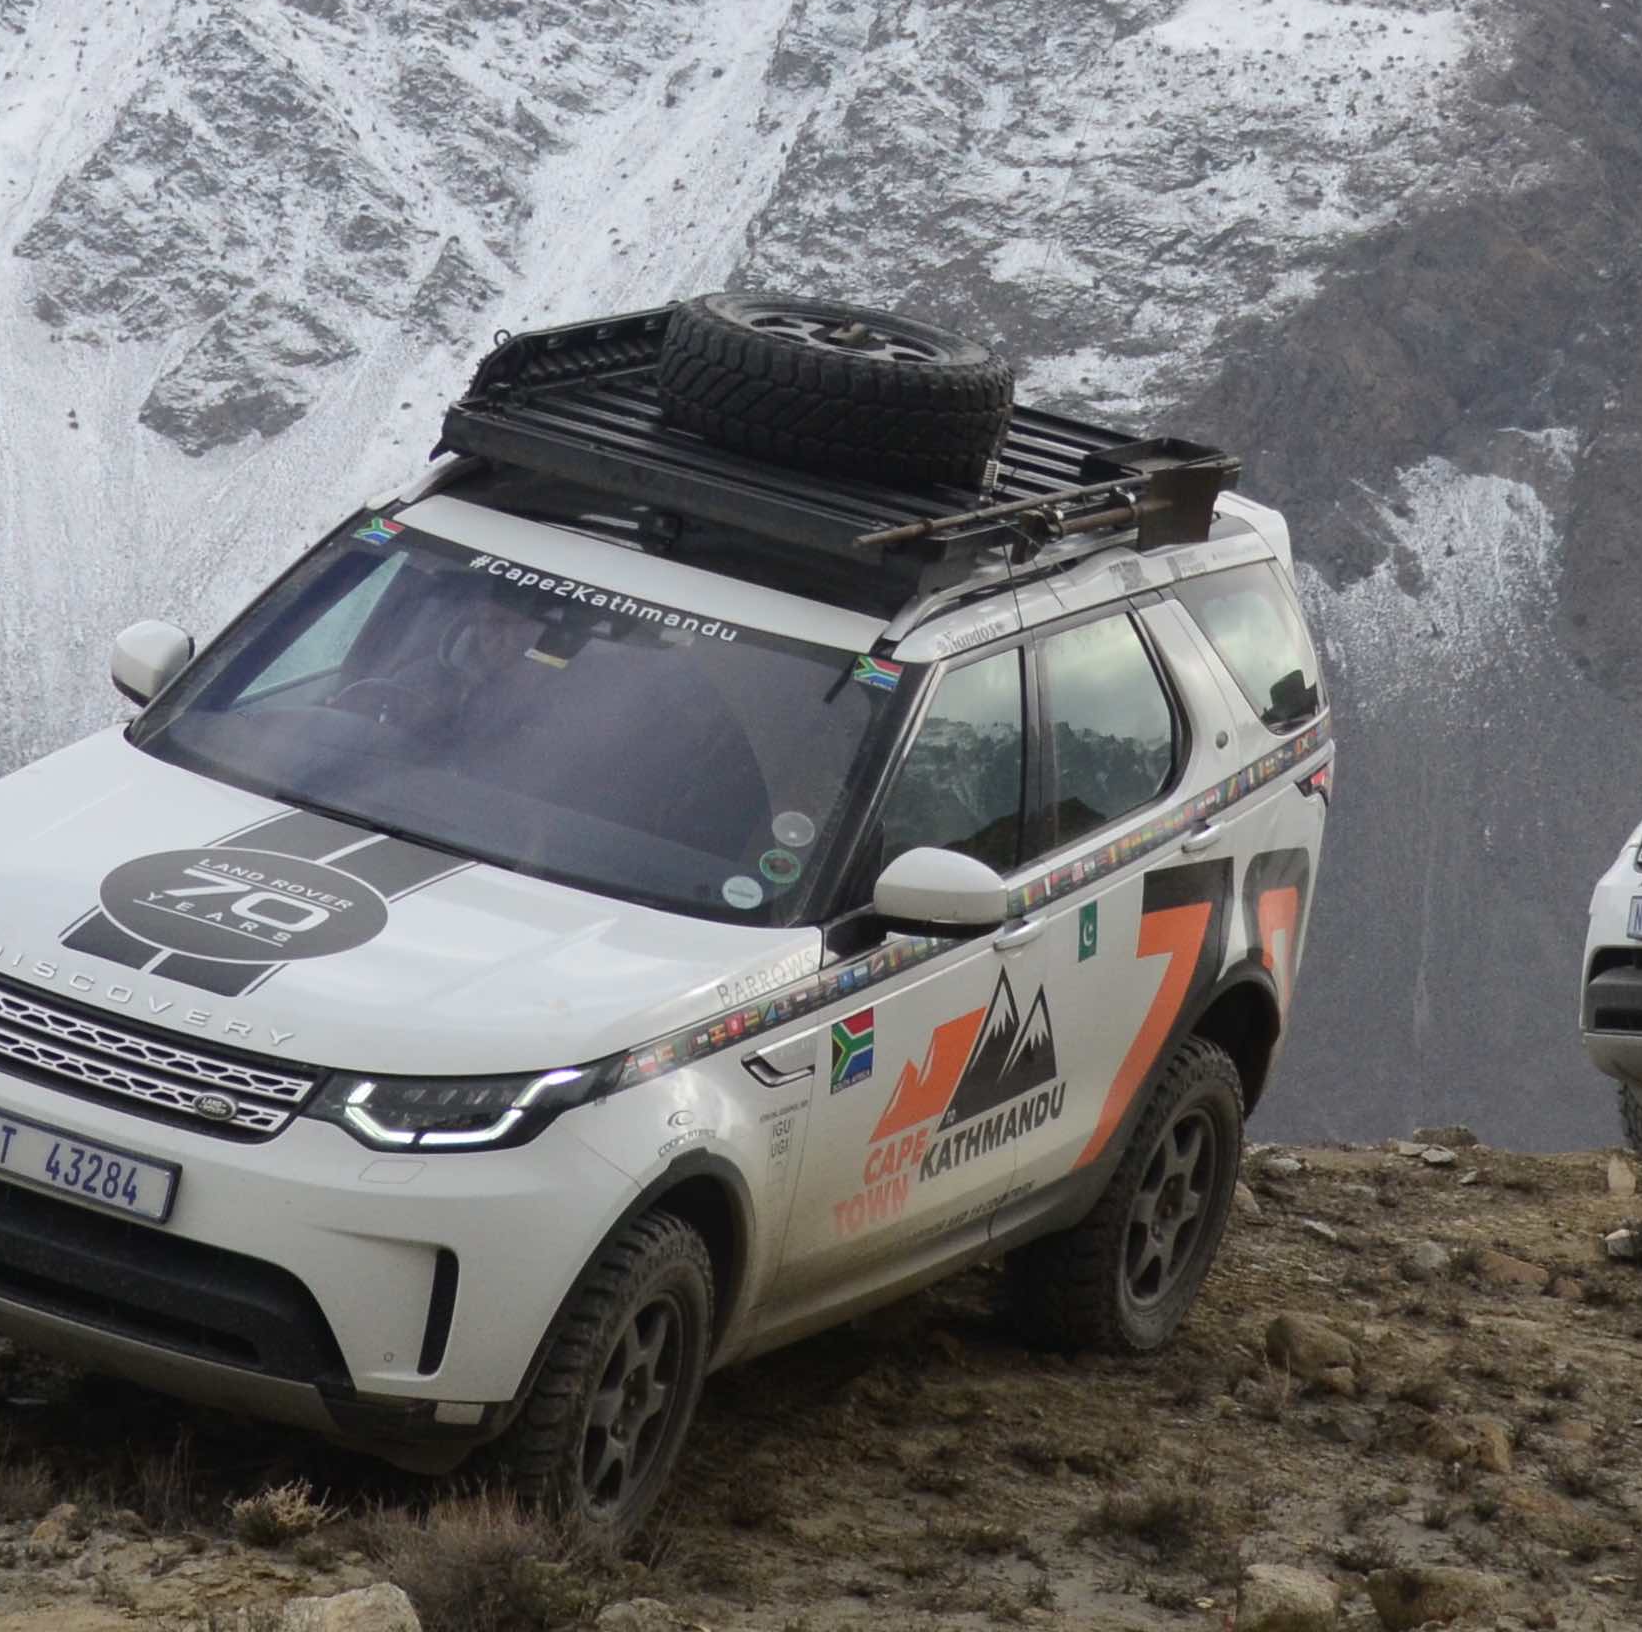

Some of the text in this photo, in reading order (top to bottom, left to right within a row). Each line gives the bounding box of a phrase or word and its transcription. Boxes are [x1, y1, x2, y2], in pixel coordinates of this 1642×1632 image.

[469, 554, 738, 642] #Cape2Kathmandu
[163, 868, 330, 932] 70
[198, 858, 355, 910] LAND ROVER
[146, 891, 292, 943] YEARS
[716, 948, 816, 1008] BARROWS
[864, 1127, 928, 1186] CAPE
[920, 1082, 1067, 1182] KATHMANDU
[45, 1143, 137, 1206] 43284
[834, 1174, 909, 1238] TOWN
